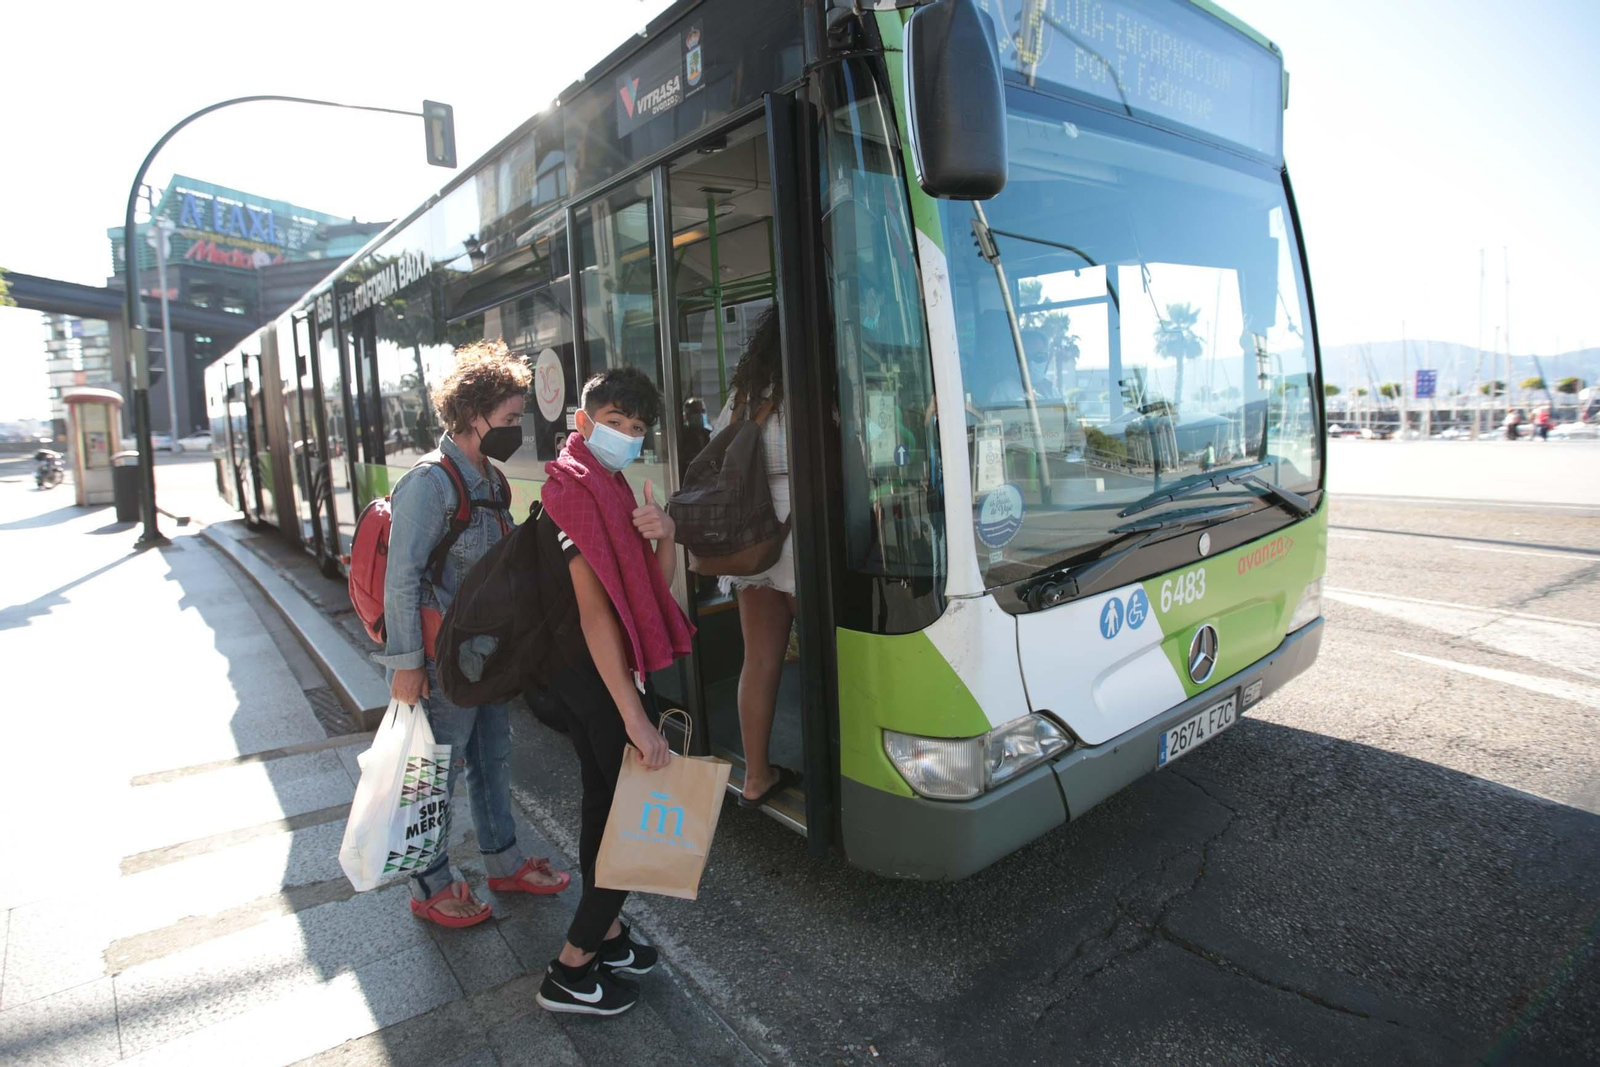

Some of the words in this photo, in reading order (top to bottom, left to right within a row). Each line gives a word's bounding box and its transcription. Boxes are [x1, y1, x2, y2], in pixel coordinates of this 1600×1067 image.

[637, 75, 680, 114] VITRASA
[398, 250, 433, 290] BAIXA
[1238, 537, 1284, 576] avanza
[1160, 568, 1206, 614] 6483
[1170, 717, 1204, 757] 2674
[1209, 701, 1233, 734] FZC
[405, 813, 445, 840] MERC
[418, 799, 448, 820] SUP
